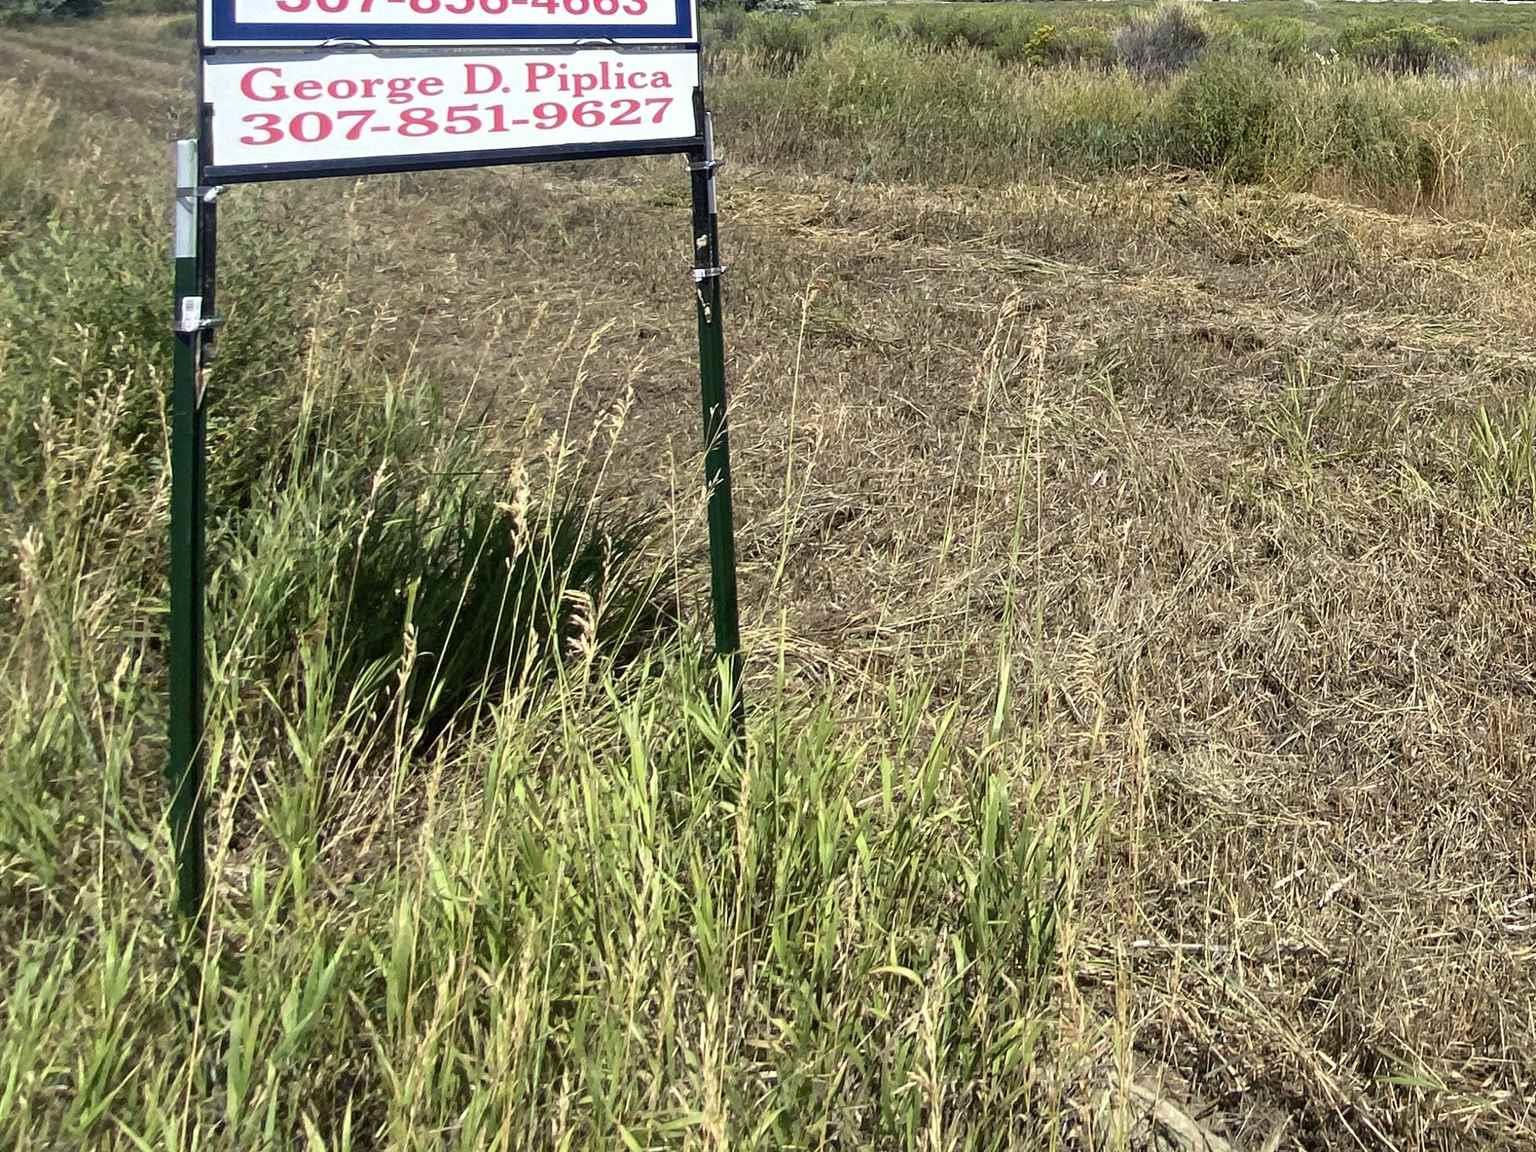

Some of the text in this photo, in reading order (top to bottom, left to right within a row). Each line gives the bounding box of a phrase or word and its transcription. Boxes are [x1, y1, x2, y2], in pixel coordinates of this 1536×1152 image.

[239, 61, 673, 105] George D. Piplica
[240, 98, 673, 145] 307-851-9627
